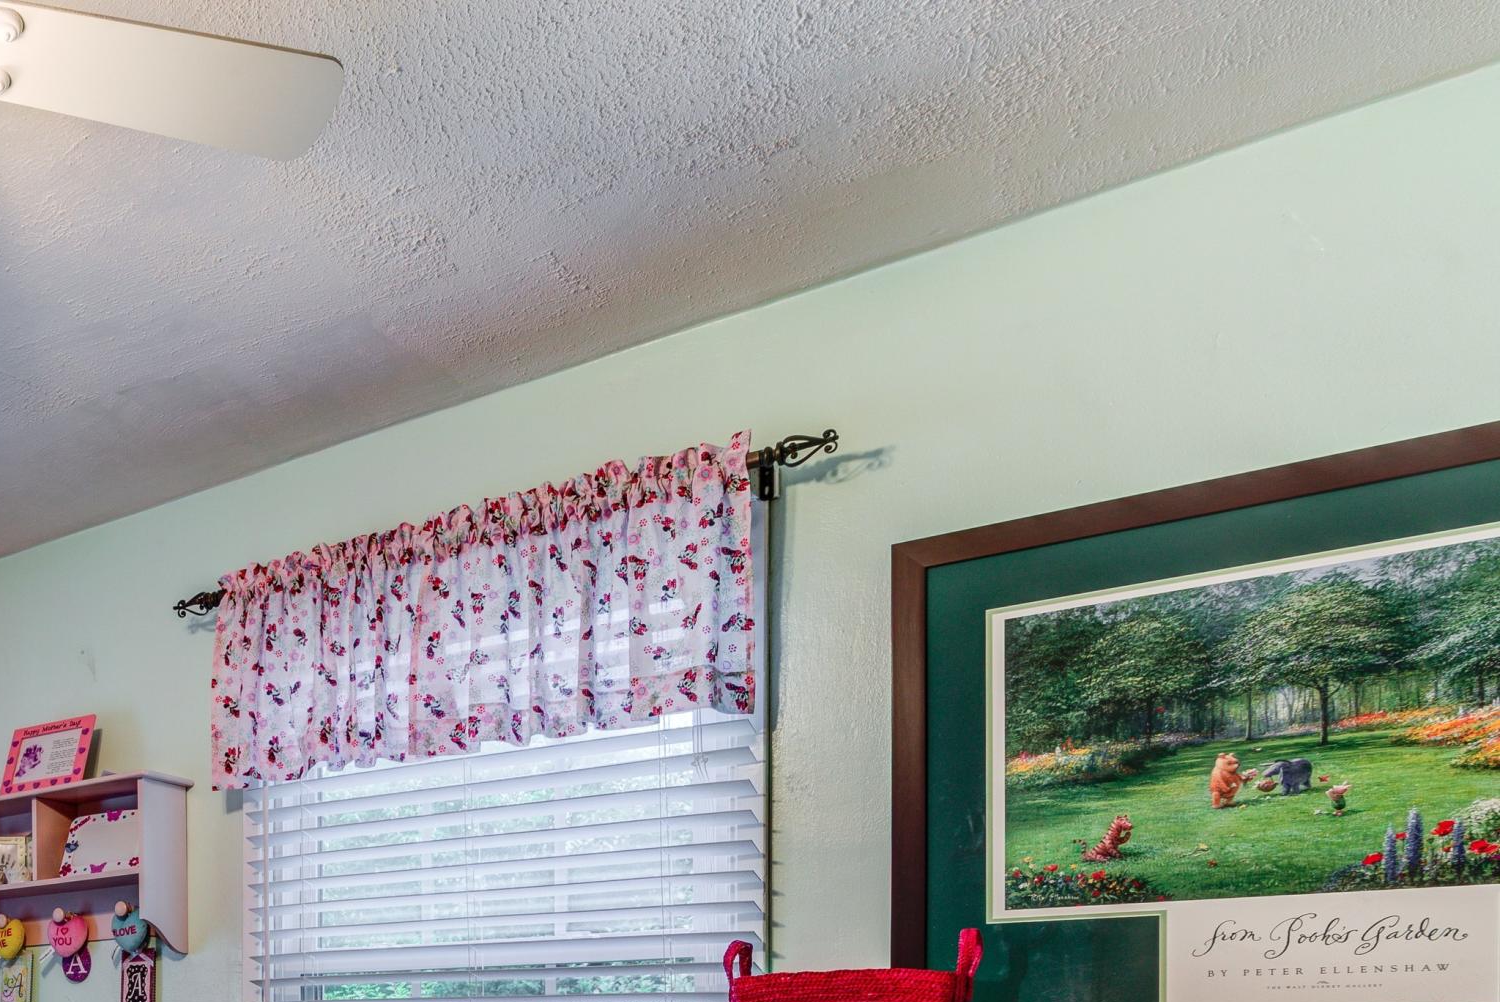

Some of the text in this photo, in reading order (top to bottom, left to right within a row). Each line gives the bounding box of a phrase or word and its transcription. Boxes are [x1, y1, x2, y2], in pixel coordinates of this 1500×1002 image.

[53, 935, 72, 946] YOU
[1192, 913, 1468, 959] from Pooh's Garden
[67, 954, 87, 974] A
[1207, 963, 1452, 977] BY PETER ELLENSHAW
[127, 971, 144, 1000] A
